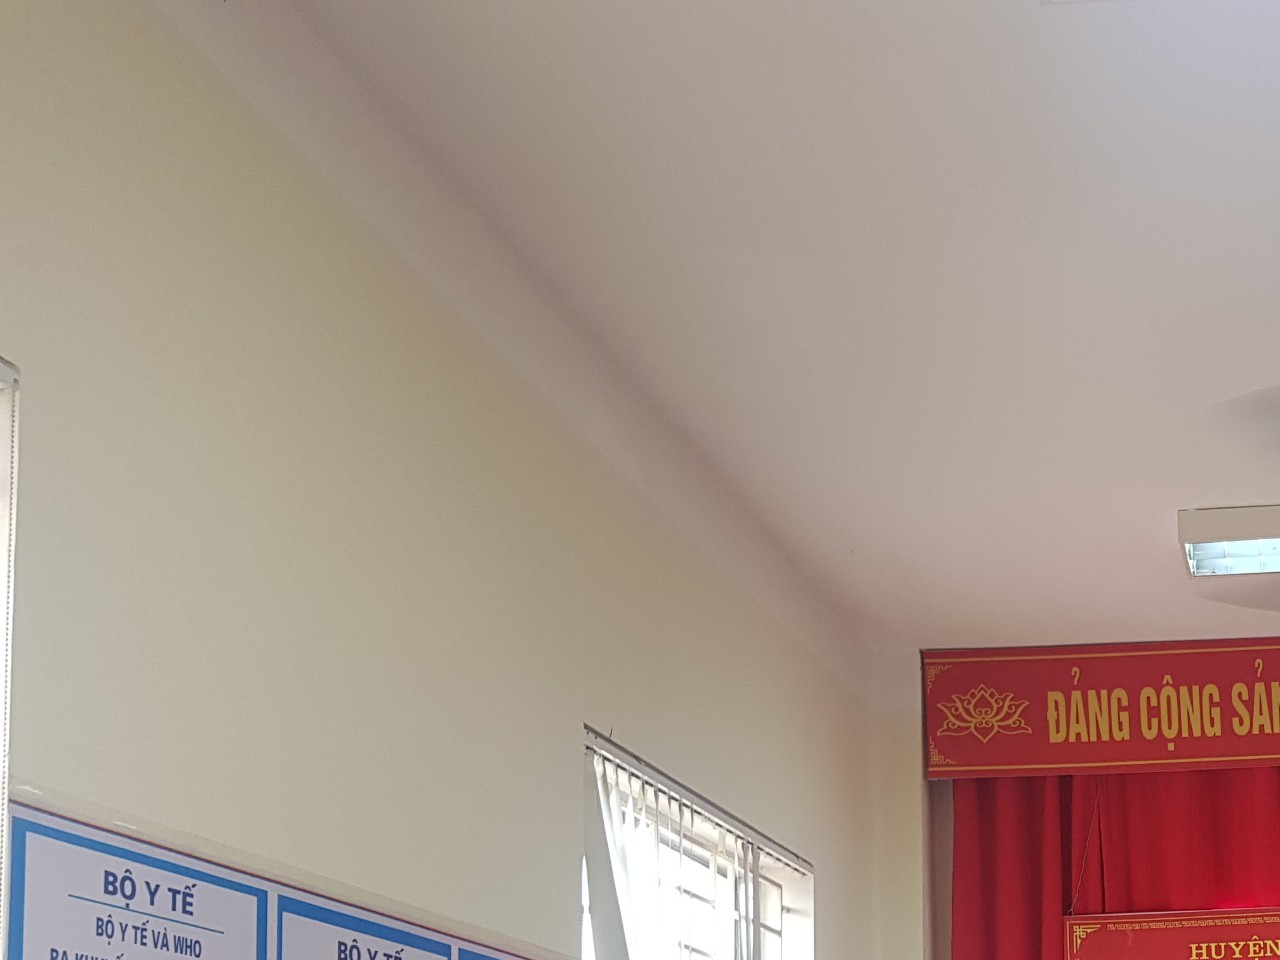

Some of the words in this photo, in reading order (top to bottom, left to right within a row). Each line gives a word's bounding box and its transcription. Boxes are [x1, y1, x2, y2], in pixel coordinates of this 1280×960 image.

[1047, 667, 1130, 743] ĐẢNG
[1139, 675, 1221, 751] CỘNG
[103, 869, 136, 908] BỘ
[145, 880, 160, 906] Y
[168, 884, 198, 916] TẾ
[96, 914, 114, 946] BỘ
[119, 922, 128, 942] Y
[132, 920, 150, 947] TẾ
[152, 928, 170, 952] VÀ
[174, 935, 202, 958] WHO
